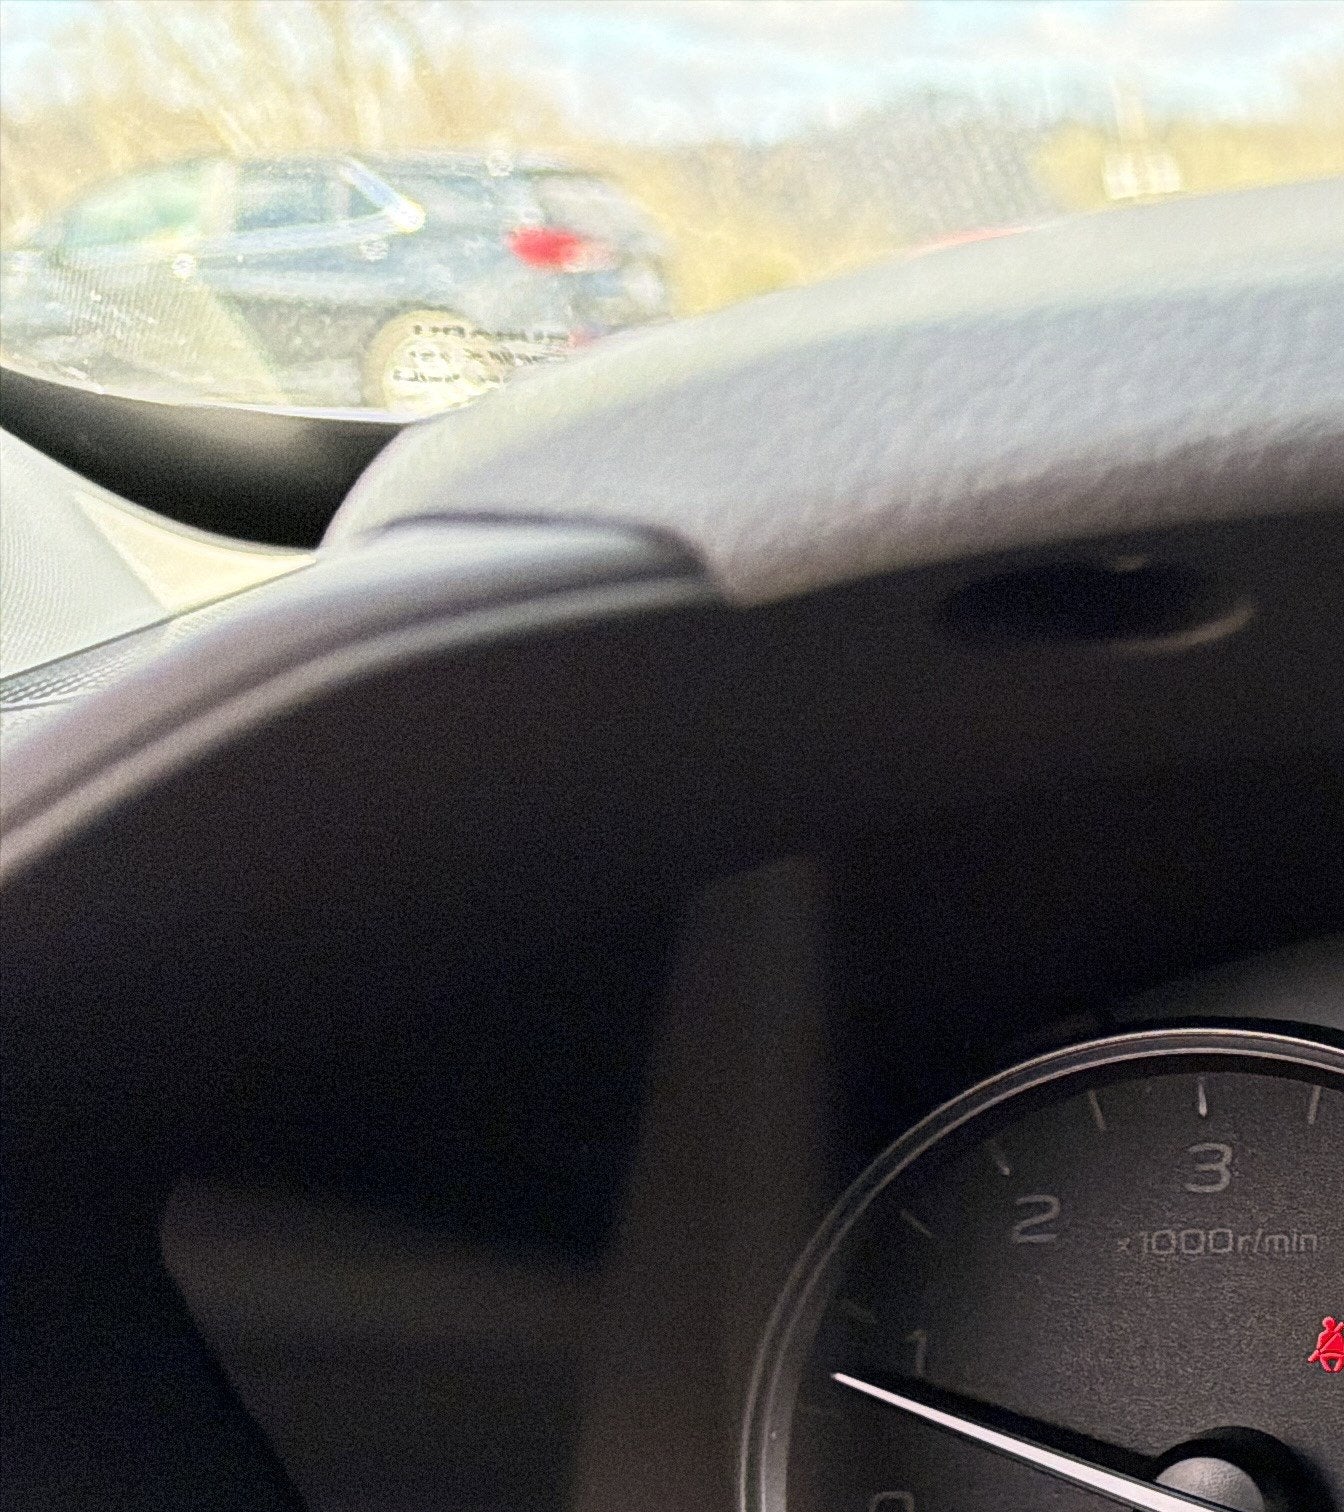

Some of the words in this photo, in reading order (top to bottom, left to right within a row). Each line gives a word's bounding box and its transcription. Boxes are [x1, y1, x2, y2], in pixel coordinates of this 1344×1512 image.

[1185, 1143, 1233, 1194] 3
[1012, 1194, 1061, 1243] 2
[904, 1329, 929, 1377] 1
